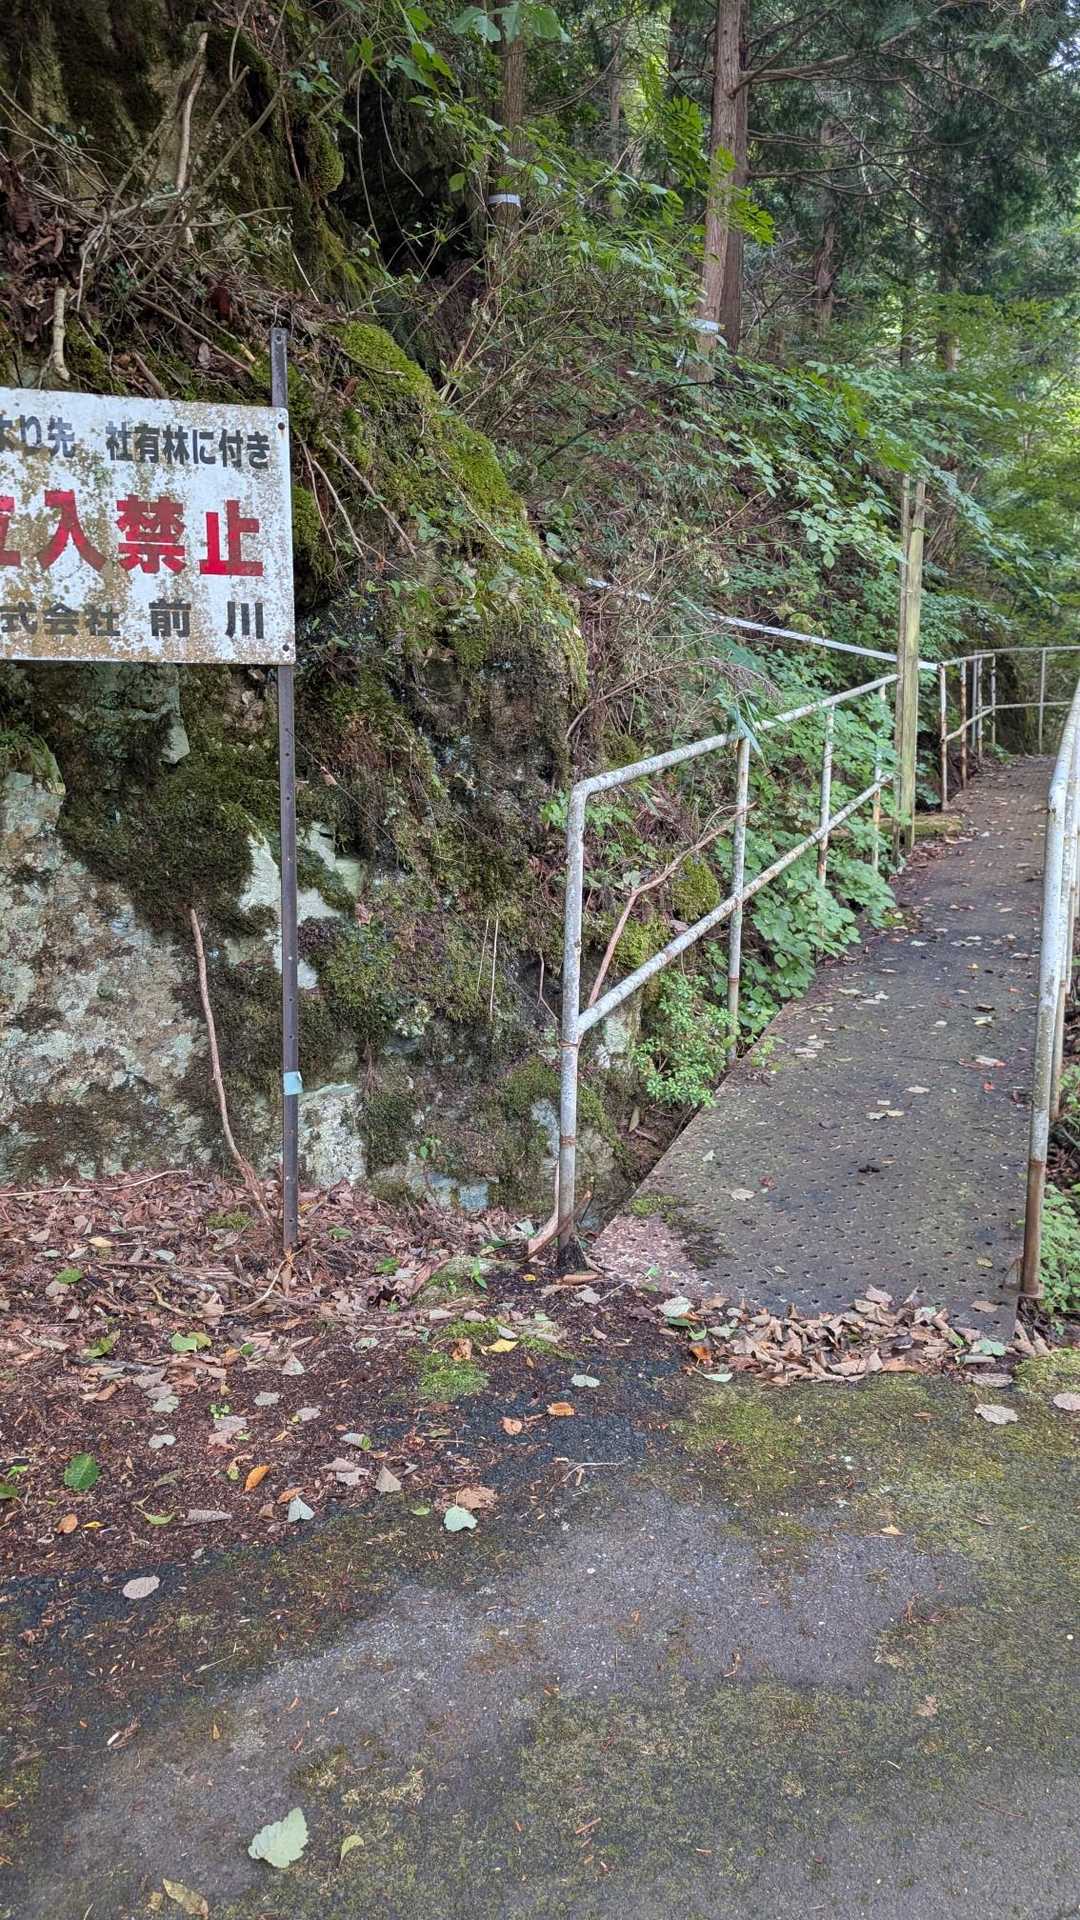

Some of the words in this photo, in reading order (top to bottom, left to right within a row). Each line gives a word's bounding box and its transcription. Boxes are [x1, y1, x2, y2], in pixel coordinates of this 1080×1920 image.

[106, 421, 271, 469] 社有林に付き
